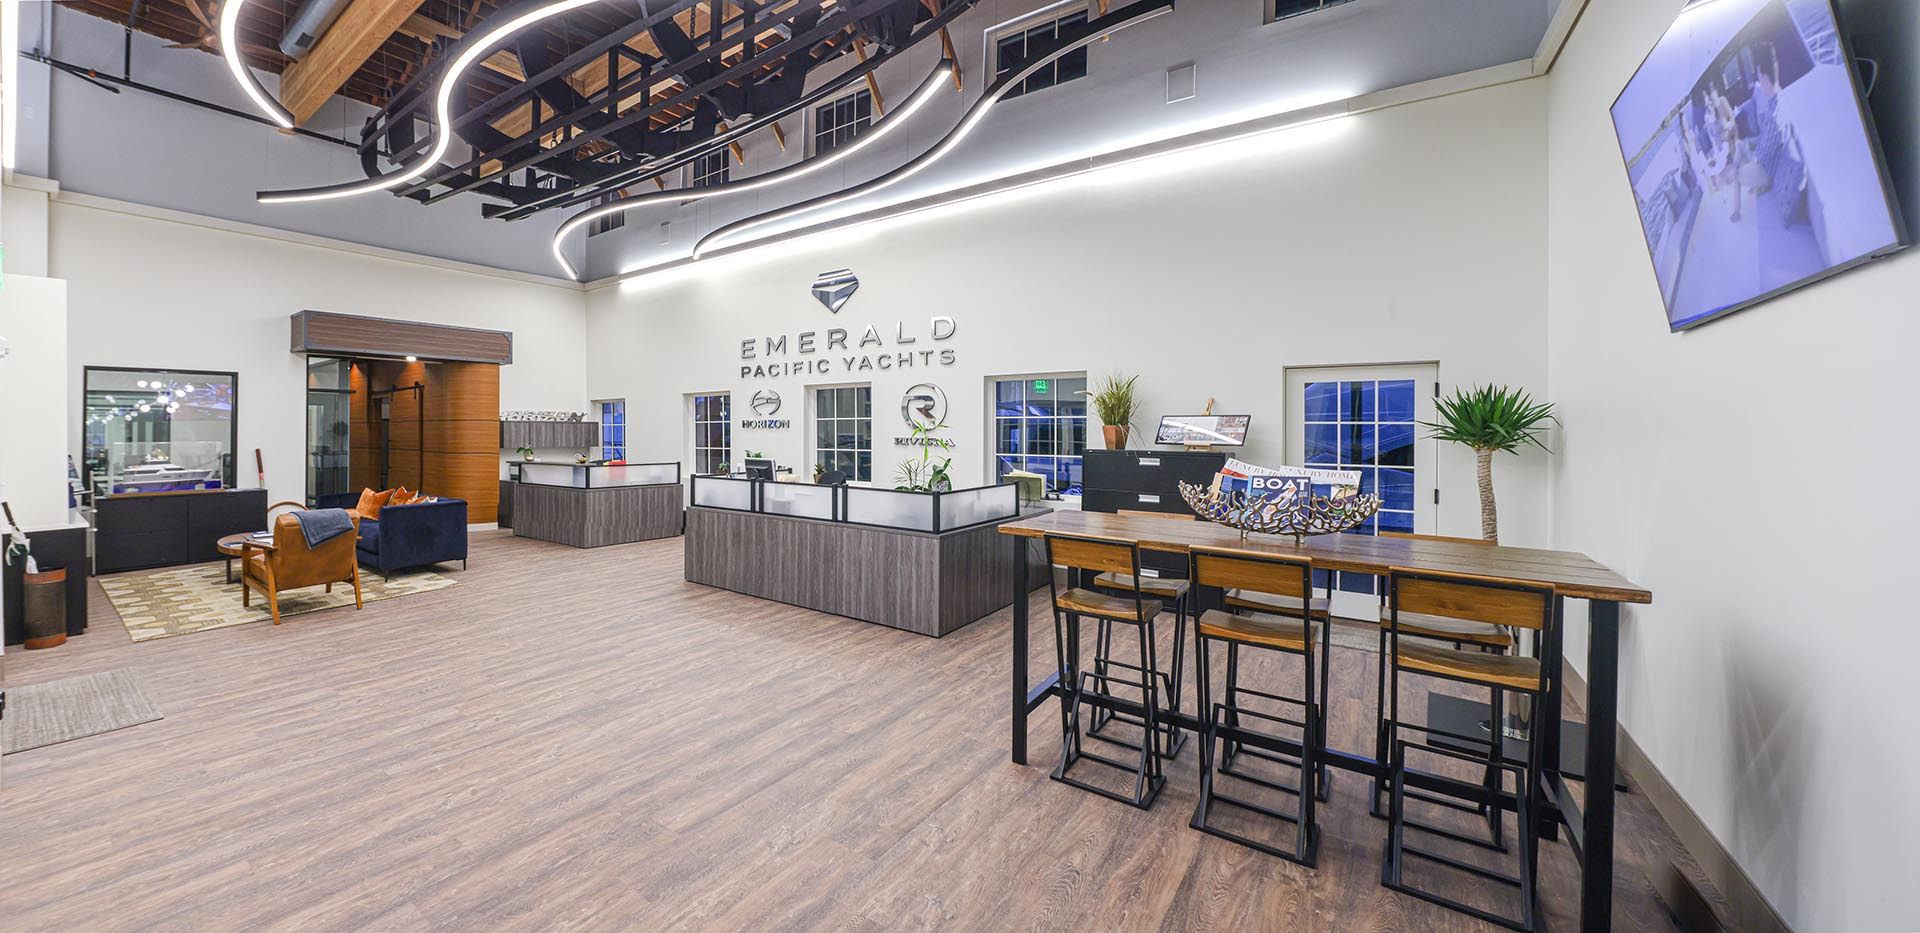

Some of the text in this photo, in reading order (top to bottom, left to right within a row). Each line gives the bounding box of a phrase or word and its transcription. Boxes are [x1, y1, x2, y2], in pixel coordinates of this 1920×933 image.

[740, 316, 956, 360] EMERALD
[740, 349, 956, 379] PACIFIC YACHTS
[741, 420, 790, 429] HORIZON
[1252, 477, 1309, 491] BOAT
